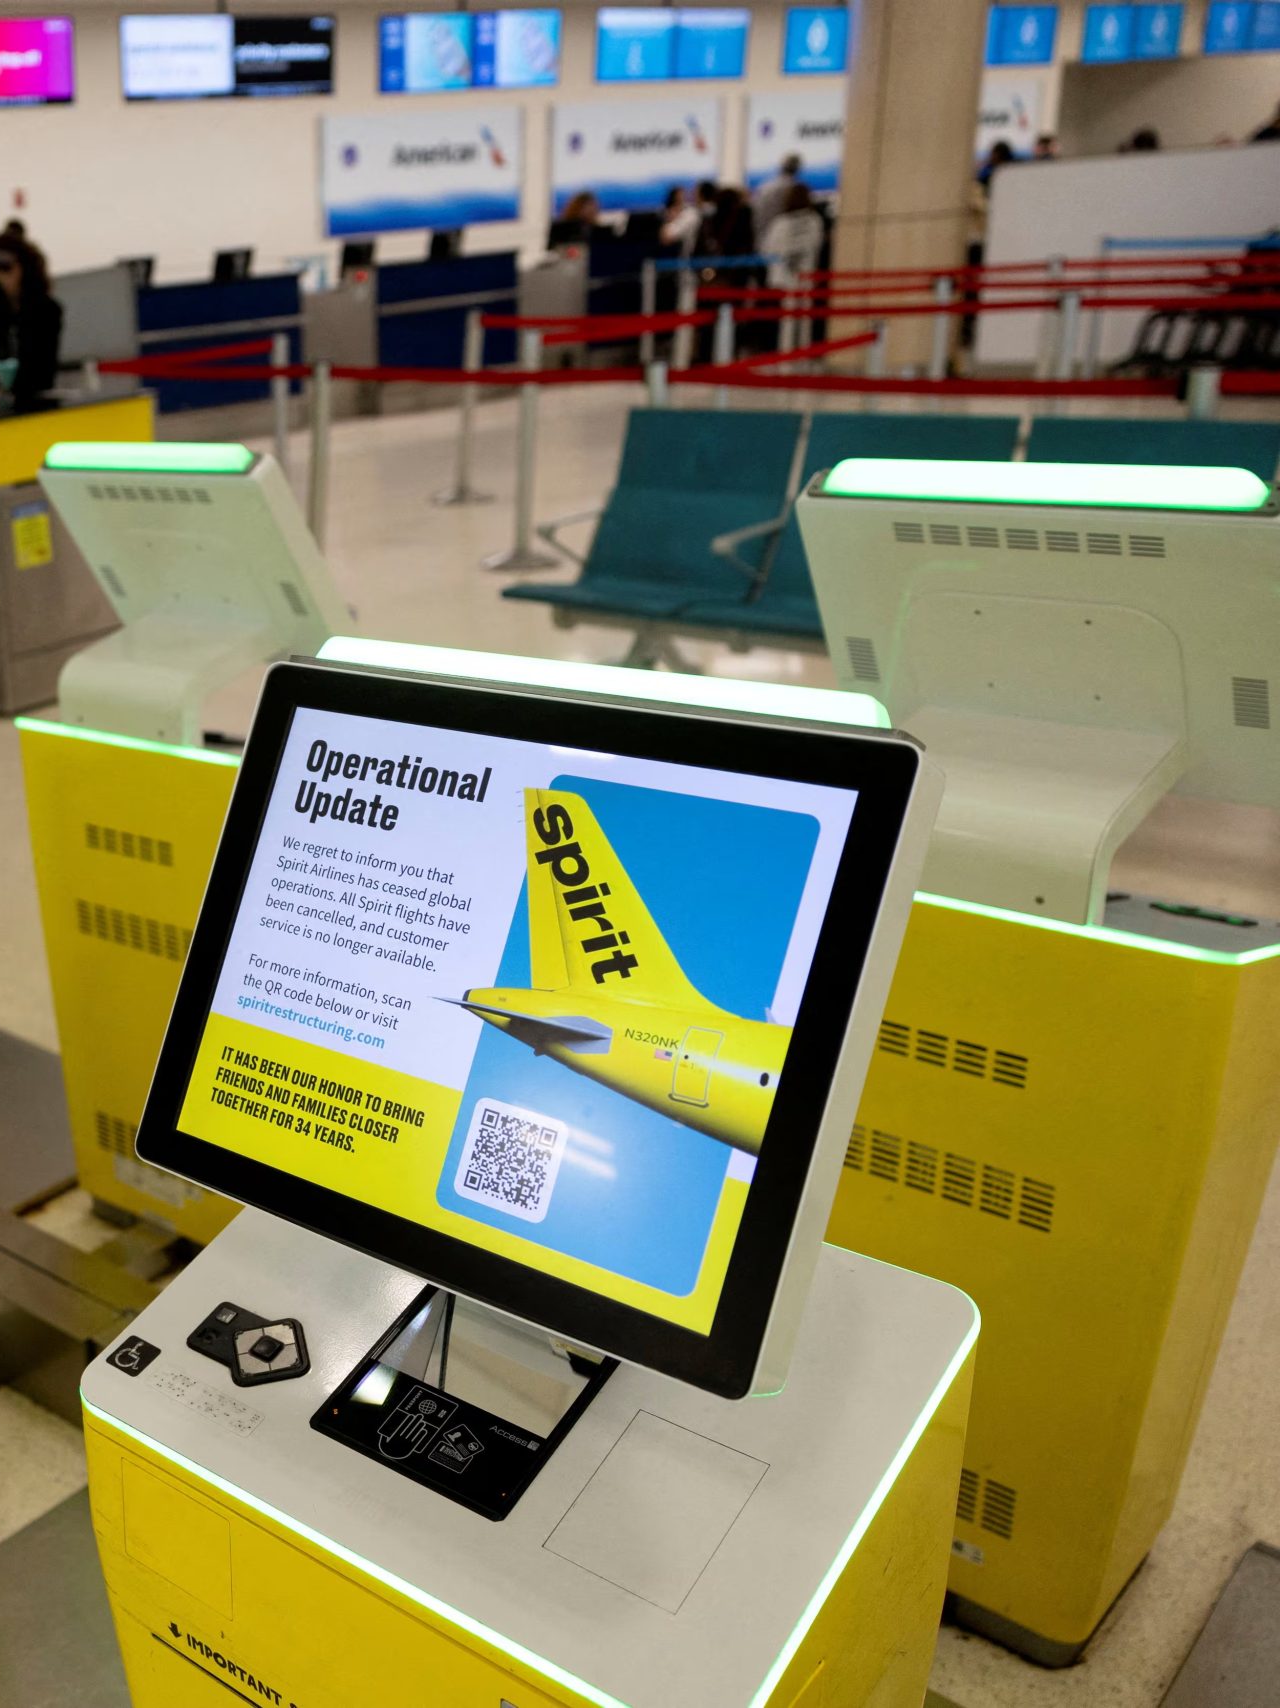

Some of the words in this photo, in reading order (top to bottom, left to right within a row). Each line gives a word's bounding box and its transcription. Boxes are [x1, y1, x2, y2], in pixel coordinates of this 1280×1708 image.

[306, 739, 493, 803] Operational
[294, 779, 399, 831] Update
[276, 855, 309, 874] Spirit
[309, 863, 355, 885] Airlines
[357, 873, 380, 890] has
[381, 882, 428, 901] ceased
[427, 891, 472, 912] global
[283, 835, 301, 851] We
[302, 843, 339, 859] regret
[340, 849, 353, 862] to
[355, 851, 397, 872] inform
[398, 864, 424, 878] you
[427, 867, 455, 885] that
[265, 893, 294, 913] been
[296, 905, 356, 931] cancelled,
[359, 921, 386, 935] and
[386, 928, 450, 951] customer
[271, 877, 336, 902] operations.
[339, 891, 357, 907] All
[357, 895, 393, 916] Spirit
[394, 903, 436, 926] flights
[437, 913, 471, 934] have
[533, 803, 639, 985] spirit
[259, 917, 301, 936] service
[302, 924, 313, 939] is
[314, 931, 331, 944] no
[333, 932, 374, 955] longer
[375, 947, 436, 972] available.
[243, 973, 262, 989] the
[264, 979, 283, 996] QR
[283, 988, 313, 1005] code
[315, 993, 354, 1016] below
[355, 1009, 370, 1021] or
[372, 1012, 399, 1030] visit
[248, 953, 269, 969] For
[269, 962, 301, 979] more
[302, 968, 378, 1004] information,
[381, 994, 411, 1011] scan
[237, 995, 385, 1049] spiritrestructuring.com
[624, 1027, 680, 1050] N320NK
[215, 1066, 265, 1096] FRIENDS
[264, 1084, 291, 1105] AND
[291, 1092, 348, 1125] FAMILIES
[348, 1112, 400, 1144] CLOSER
[221, 1045, 235, 1062] IT
[234, 1050, 259, 1071] HAS
[258, 1058, 291, 1082] BEEN
[291, 1069, 318, 1091] OUR
[317, 1078, 363, 1107] HONOR
[365, 1093, 382, 1113] TO
[382, 1100, 425, 1128] BRING
[211, 1086, 269, 1121] TOGETHER
[269, 1108, 294, 1130] FOR
[294, 1117, 312, 1136] 34
[313, 1123, 355, 1153] YEARS.
[187, 1633, 282, 1706] IMPORTANT
